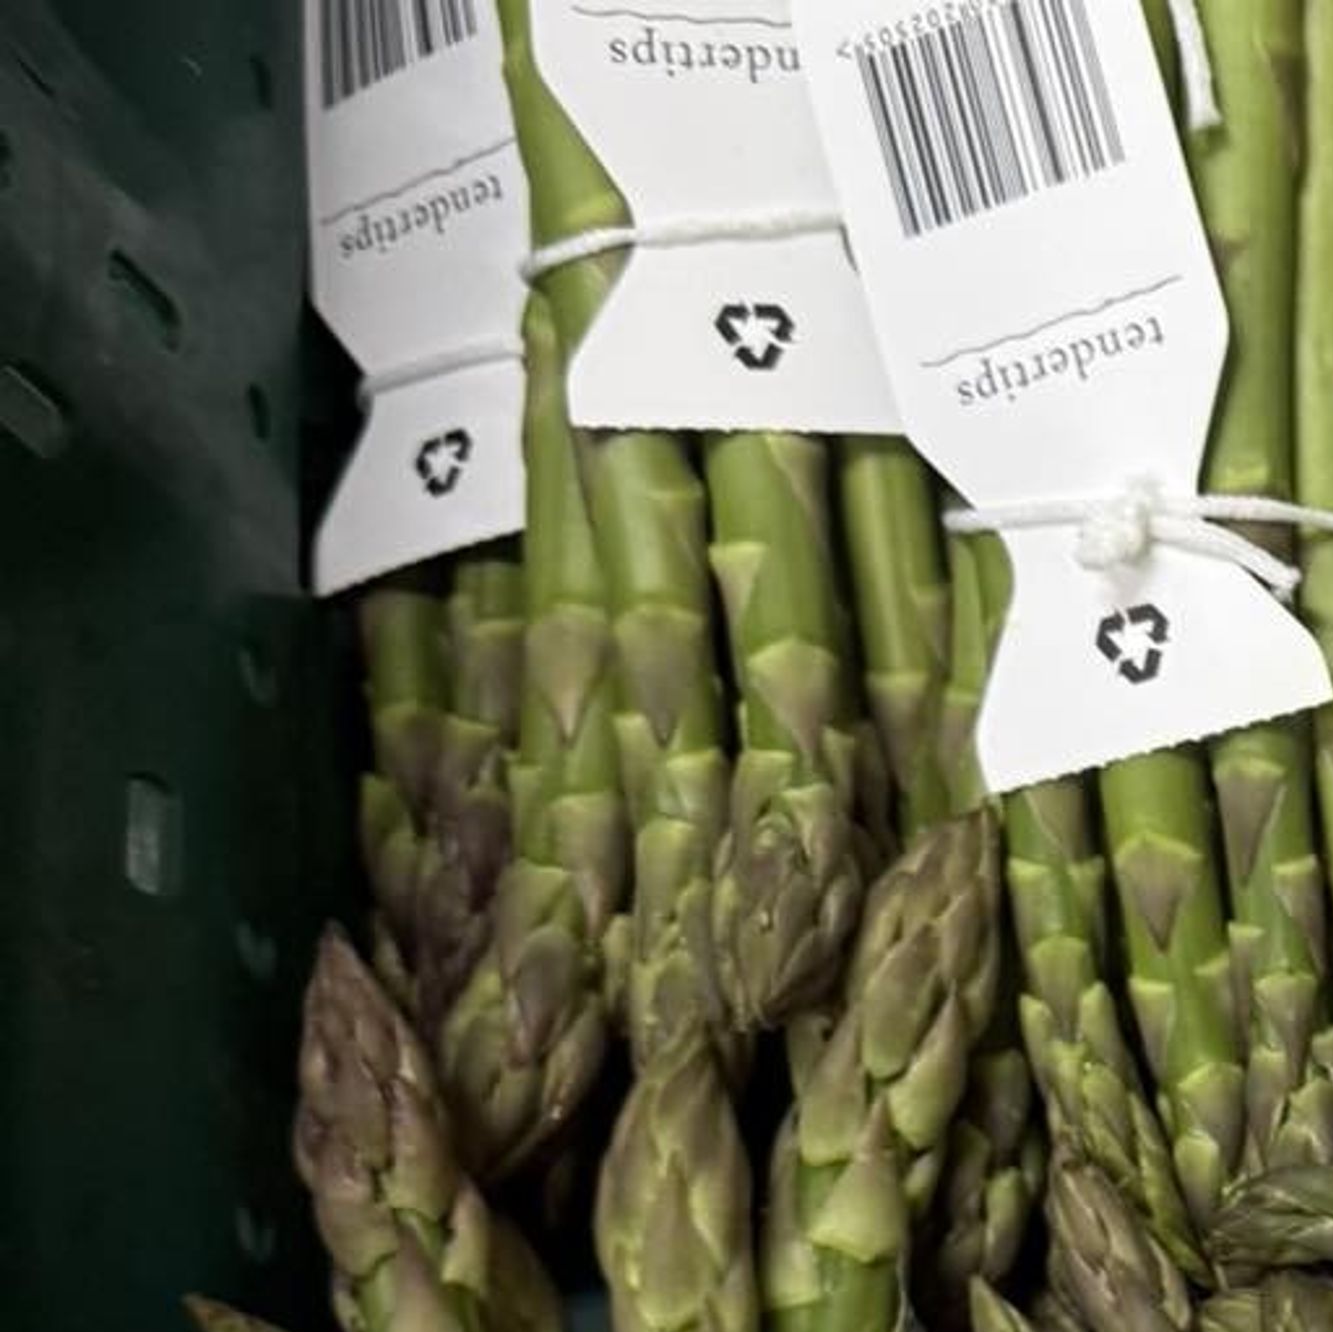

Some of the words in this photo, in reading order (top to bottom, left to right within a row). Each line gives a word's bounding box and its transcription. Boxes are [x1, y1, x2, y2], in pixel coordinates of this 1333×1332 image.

[609, 27, 800, 84] ndertips
[340, 174, 503, 260] tendertips
[956, 316, 1164, 407] tendertips
